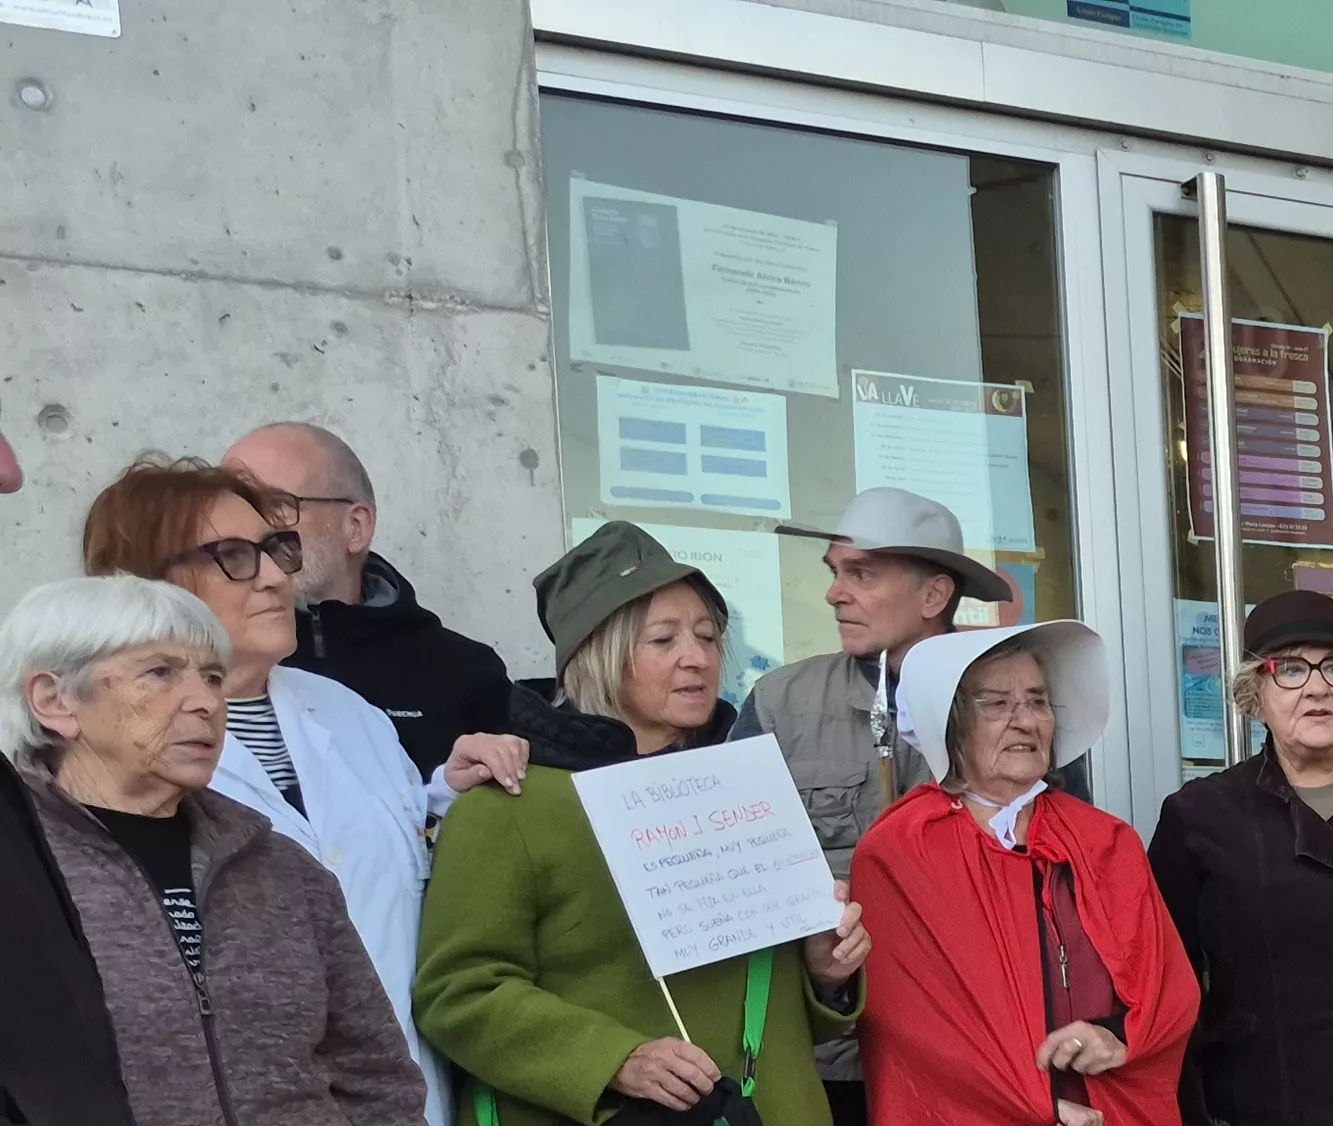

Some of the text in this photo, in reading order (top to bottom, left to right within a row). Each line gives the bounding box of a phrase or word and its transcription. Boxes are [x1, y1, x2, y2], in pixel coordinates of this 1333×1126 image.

[622, 792, 645, 812] LA
[630, 819, 688, 850] RAMON
[708, 800, 776, 832] SENDER
[645, 884, 672, 900] TAN
[661, 923, 693, 942] PERO
[674, 943, 700, 960] MUY
